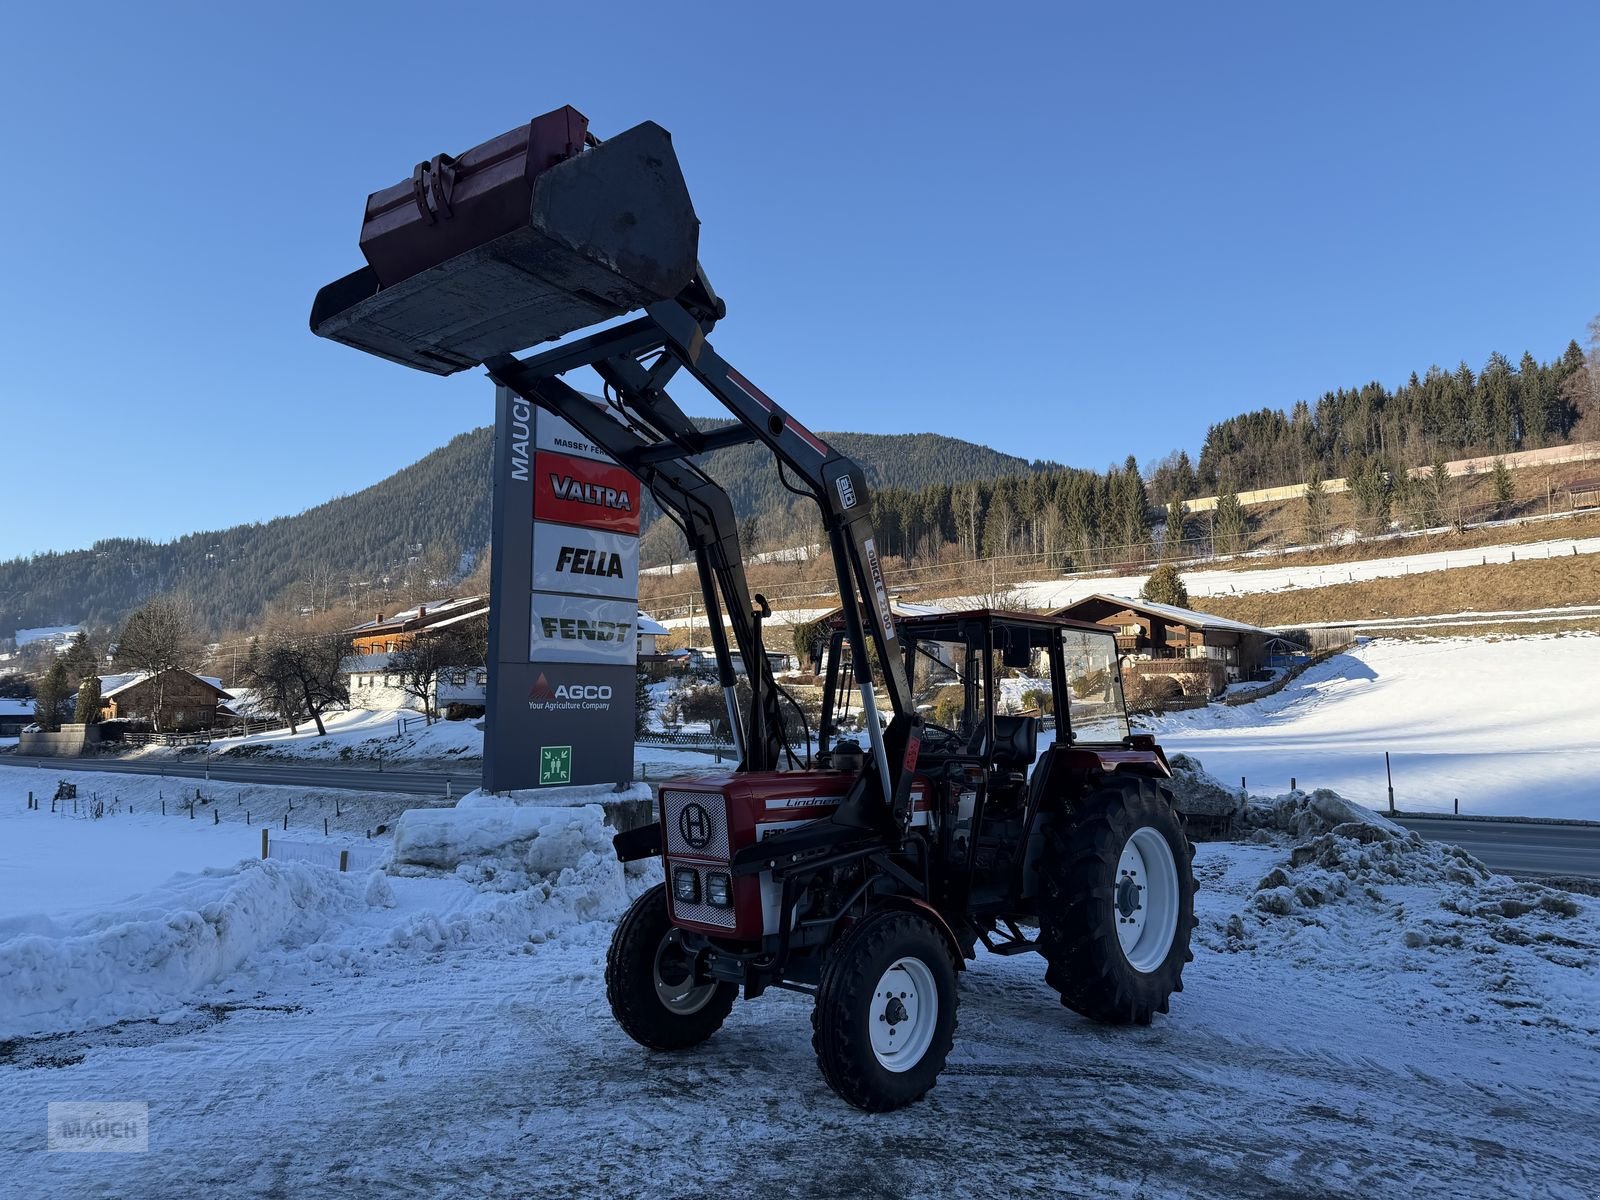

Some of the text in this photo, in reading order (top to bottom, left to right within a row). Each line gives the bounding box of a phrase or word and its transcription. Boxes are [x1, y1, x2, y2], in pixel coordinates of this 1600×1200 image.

[554, 438, 588, 452] MASSEY
[549, 473, 631, 512] VALTRA
[555, 546, 624, 579] FELLA
[540, 616, 632, 643] FENDT
[554, 685, 612, 700] AGCO
[528, 701, 610, 712] Your Agriculture Company
